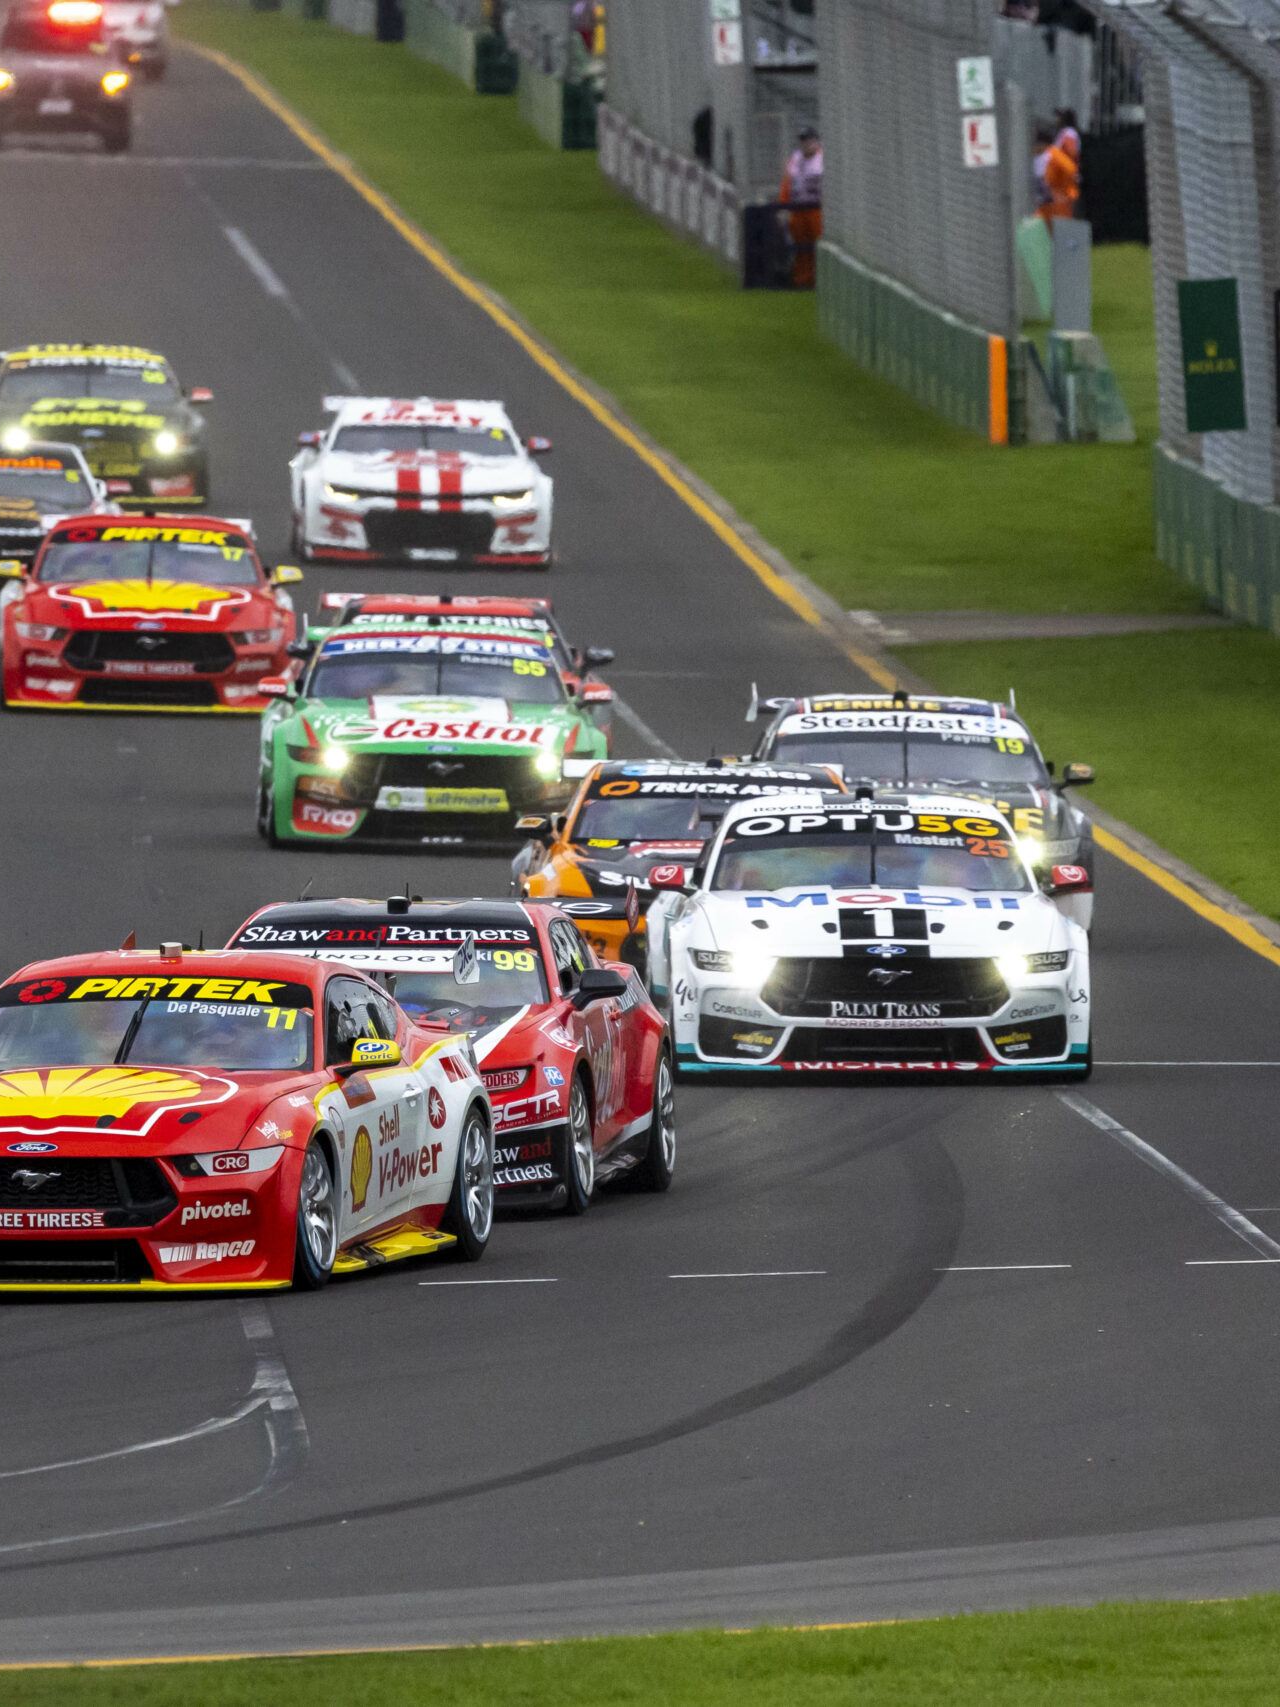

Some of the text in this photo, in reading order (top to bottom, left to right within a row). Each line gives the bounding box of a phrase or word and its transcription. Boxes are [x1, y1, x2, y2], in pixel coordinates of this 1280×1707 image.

[101, 527, 230, 546] PIRTEK
[221, 546, 244, 562] 17
[513, 658, 547, 677] 55
[813, 700, 941, 711] PENRITE
[383, 718, 546, 746] Castrol
[799, 715, 969, 731] Steadfast
[940, 733, 991, 745] Payne
[994, 737, 1024, 755] 19
[894, 833, 964, 848] Mostert
[966, 838, 1009, 858] 25
[744, 892, 1020, 910] Mobil
[863, 909, 895, 937] 1
[492, 950, 535, 972] 99
[68, 976, 287, 1004] PIRTEK
[167, 1001, 261, 1018] De Pasquale
[830, 1001, 941, 1019] PALM TRANS
[263, 1007, 298, 1031] 11
[824, 1019, 945, 1028] MORRIS PERSONAL
[359, 1052, 393, 1062] Doric
[378, 1103, 400, 1147] Shell
[19, 1142, 49, 1153] Ford
[214, 1153, 248, 1170] CRC
[378, 1141, 443, 1199] V-Power
[27, 1212, 92, 1228] THREES
[181, 1199, 251, 1226] pivotel.
[195, 1240, 256, 1261] Repco
